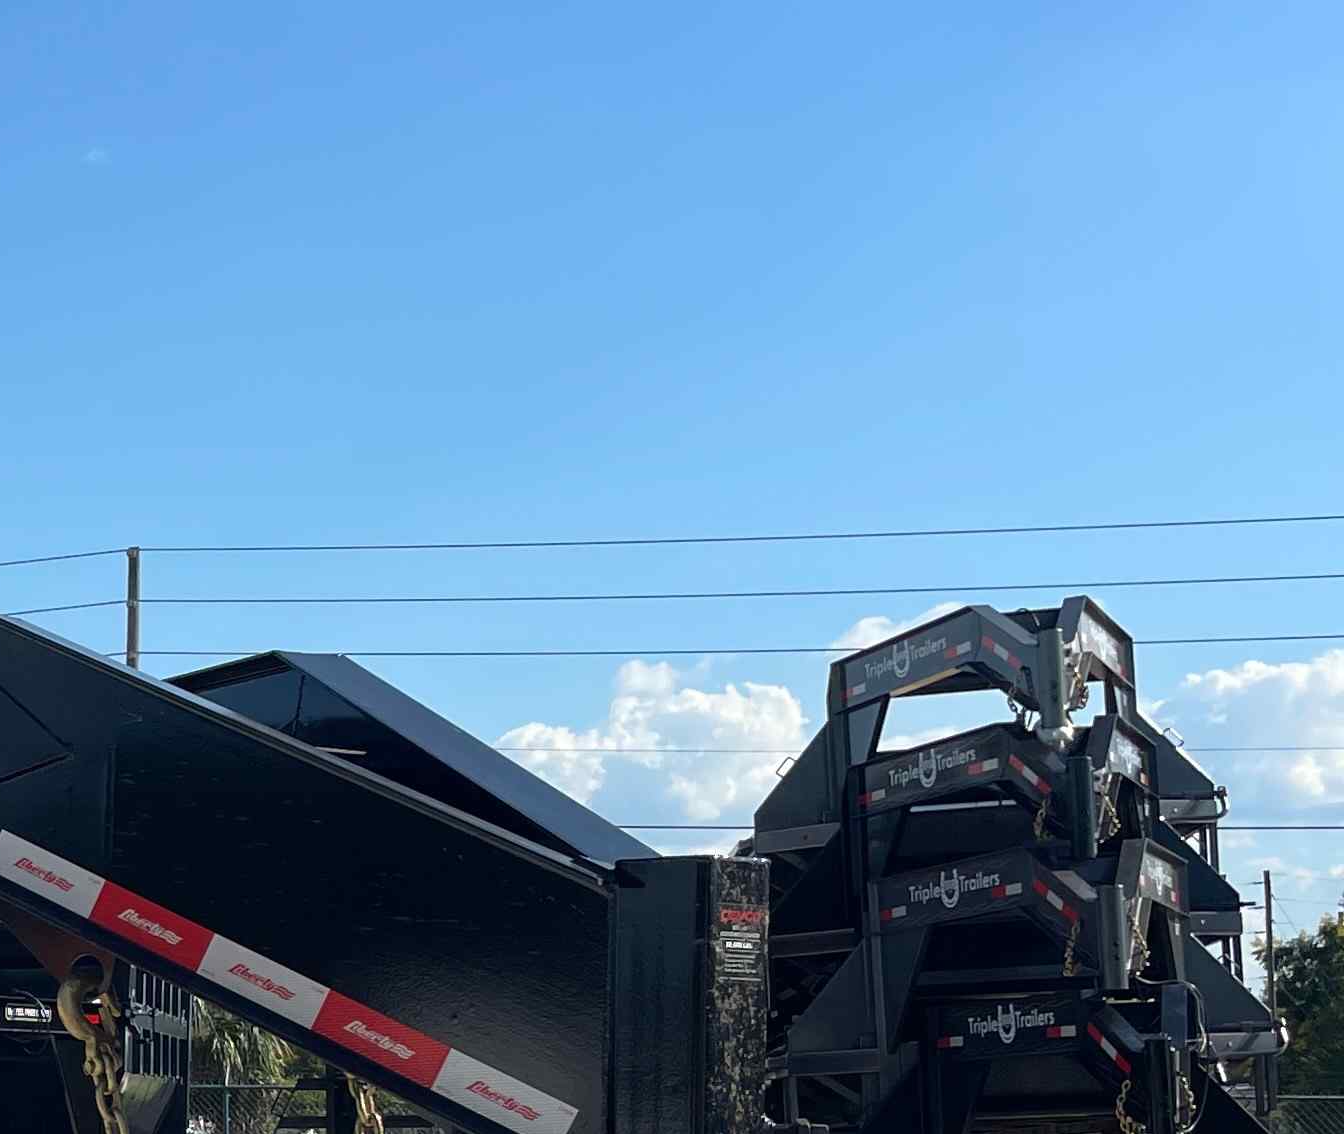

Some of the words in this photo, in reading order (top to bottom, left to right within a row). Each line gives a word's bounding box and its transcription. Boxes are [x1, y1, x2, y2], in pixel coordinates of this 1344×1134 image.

[888, 764, 920, 787] Triple
[936, 749, 976, 771] Trailers
[908, 881, 942, 904] Triple
[958, 872, 1000, 893] Trailers
[968, 1015, 1000, 1037] Triple
[1014, 1008, 1055, 1029] Trailers
